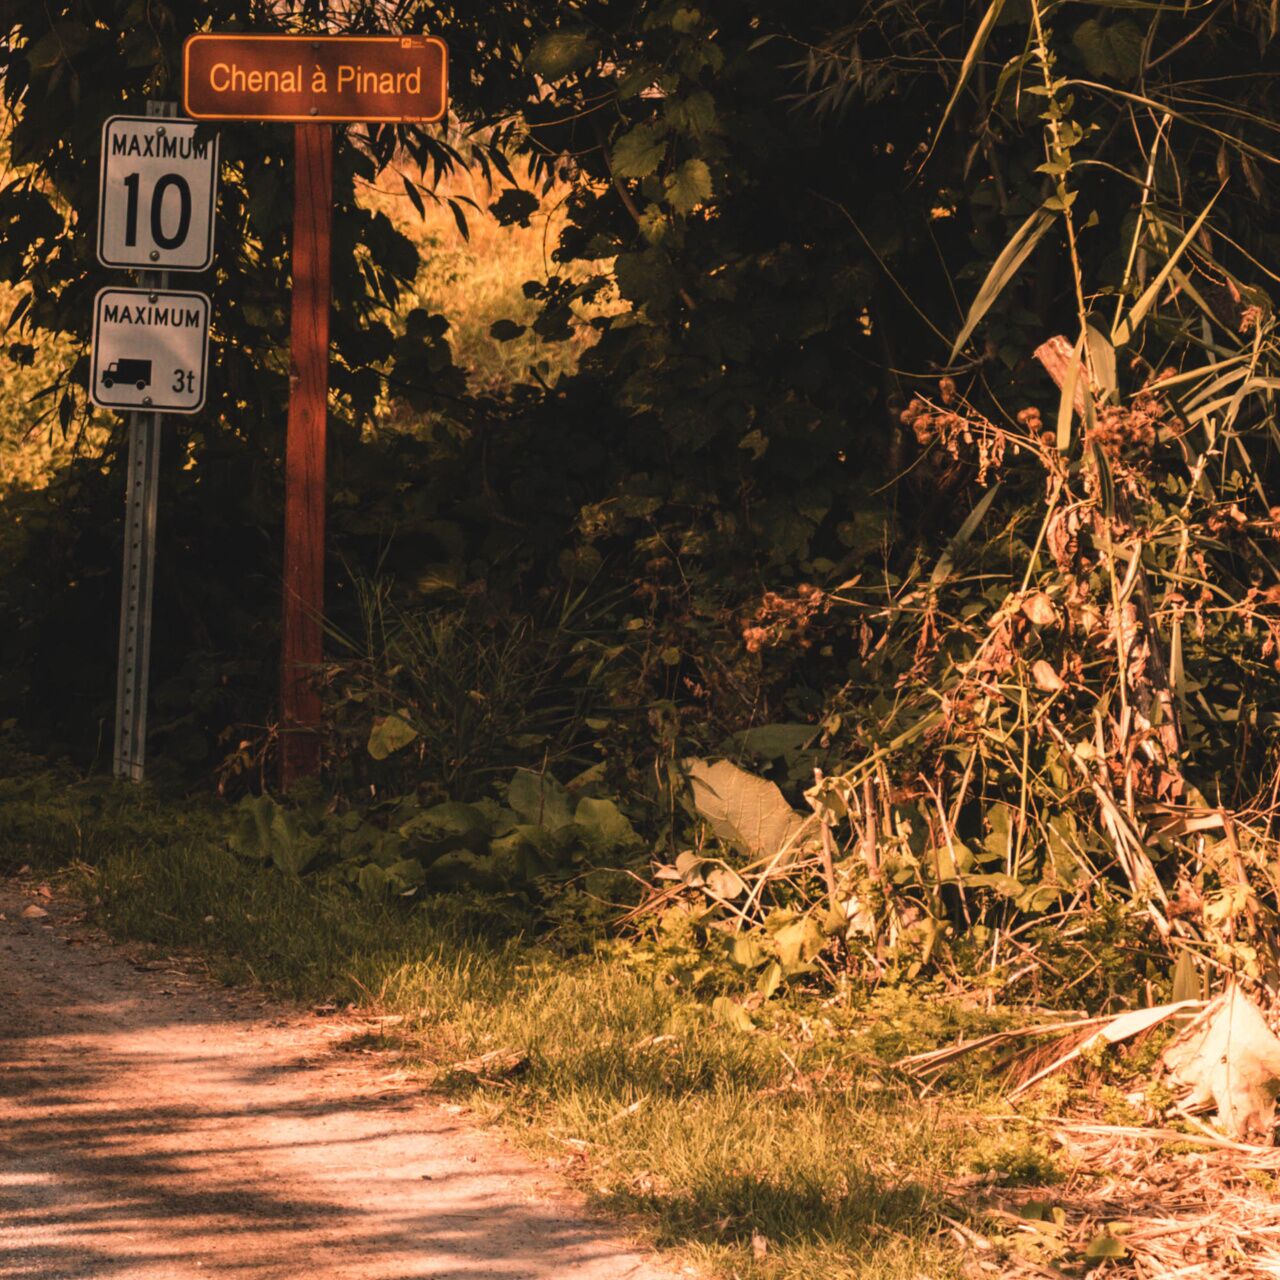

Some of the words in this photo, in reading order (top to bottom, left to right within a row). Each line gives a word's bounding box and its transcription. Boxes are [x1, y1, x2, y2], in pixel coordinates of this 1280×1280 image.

[209, 63, 303, 93] Chenal
[311, 65, 327, 94] à
[337, 65, 422, 95] Pinard
[123, 172, 193, 251] 10
[103, 304, 200, 329] MAXIMUM
[171, 369, 196, 394] 3t
